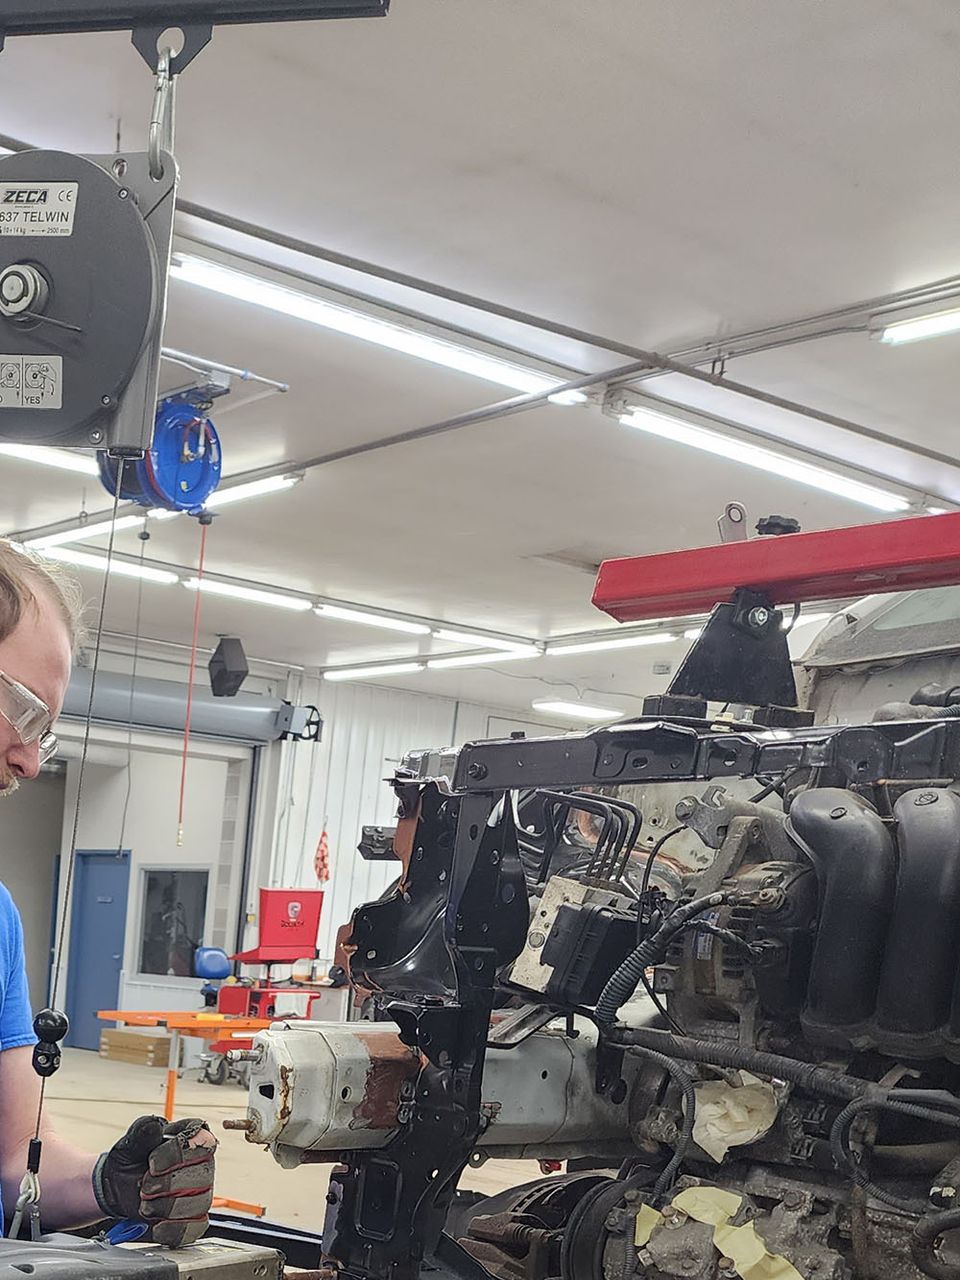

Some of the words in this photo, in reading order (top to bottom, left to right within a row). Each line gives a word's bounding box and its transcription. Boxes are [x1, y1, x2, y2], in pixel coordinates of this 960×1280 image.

[2, 190, 48, 203] ZECA
[23, 211, 70, 223] TELWIN
[25, 396, 41, 404] YES
